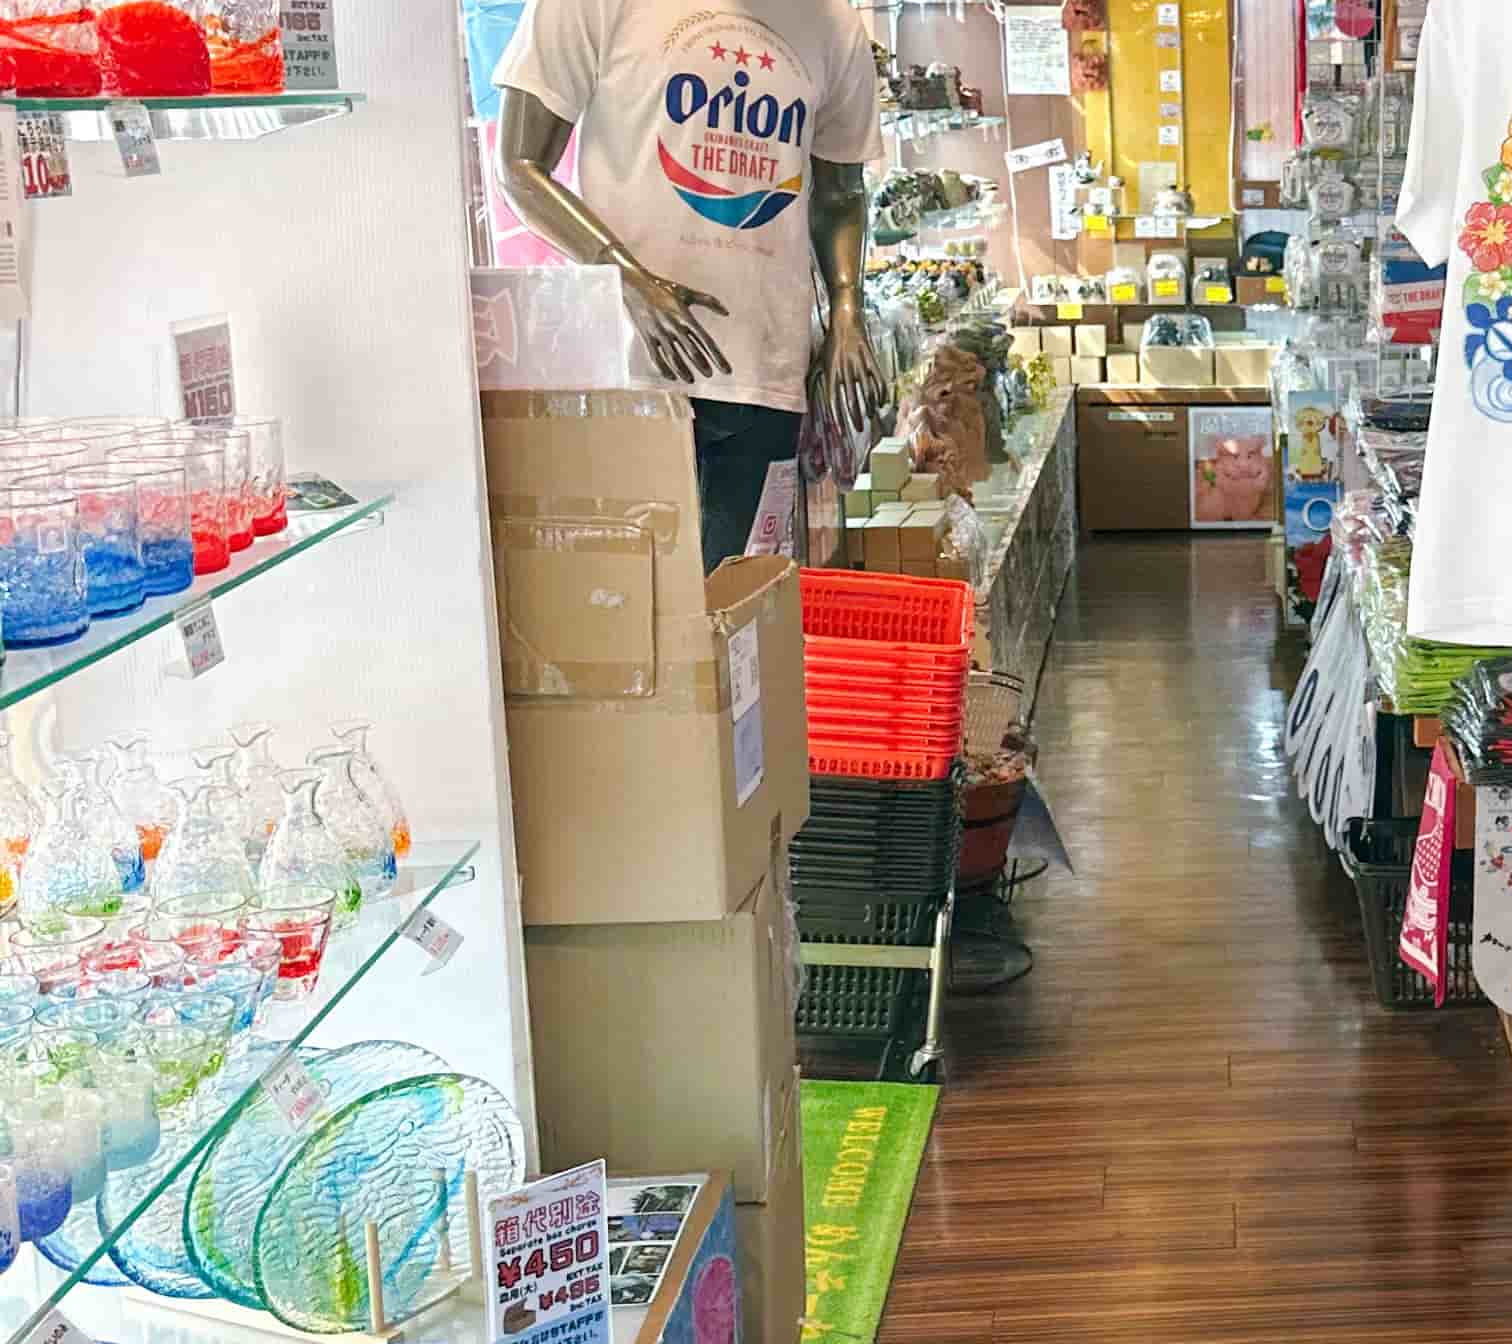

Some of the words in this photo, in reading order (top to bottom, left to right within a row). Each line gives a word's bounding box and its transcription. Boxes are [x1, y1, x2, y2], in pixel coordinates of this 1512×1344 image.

[665, 69, 807, 147] Orion
[691, 142, 727, 174] THE
[728, 147, 780, 185] DRAFT
[494, 1190, 600, 1248] 箱代別途
[497, 1229, 600, 1289] ¥450
